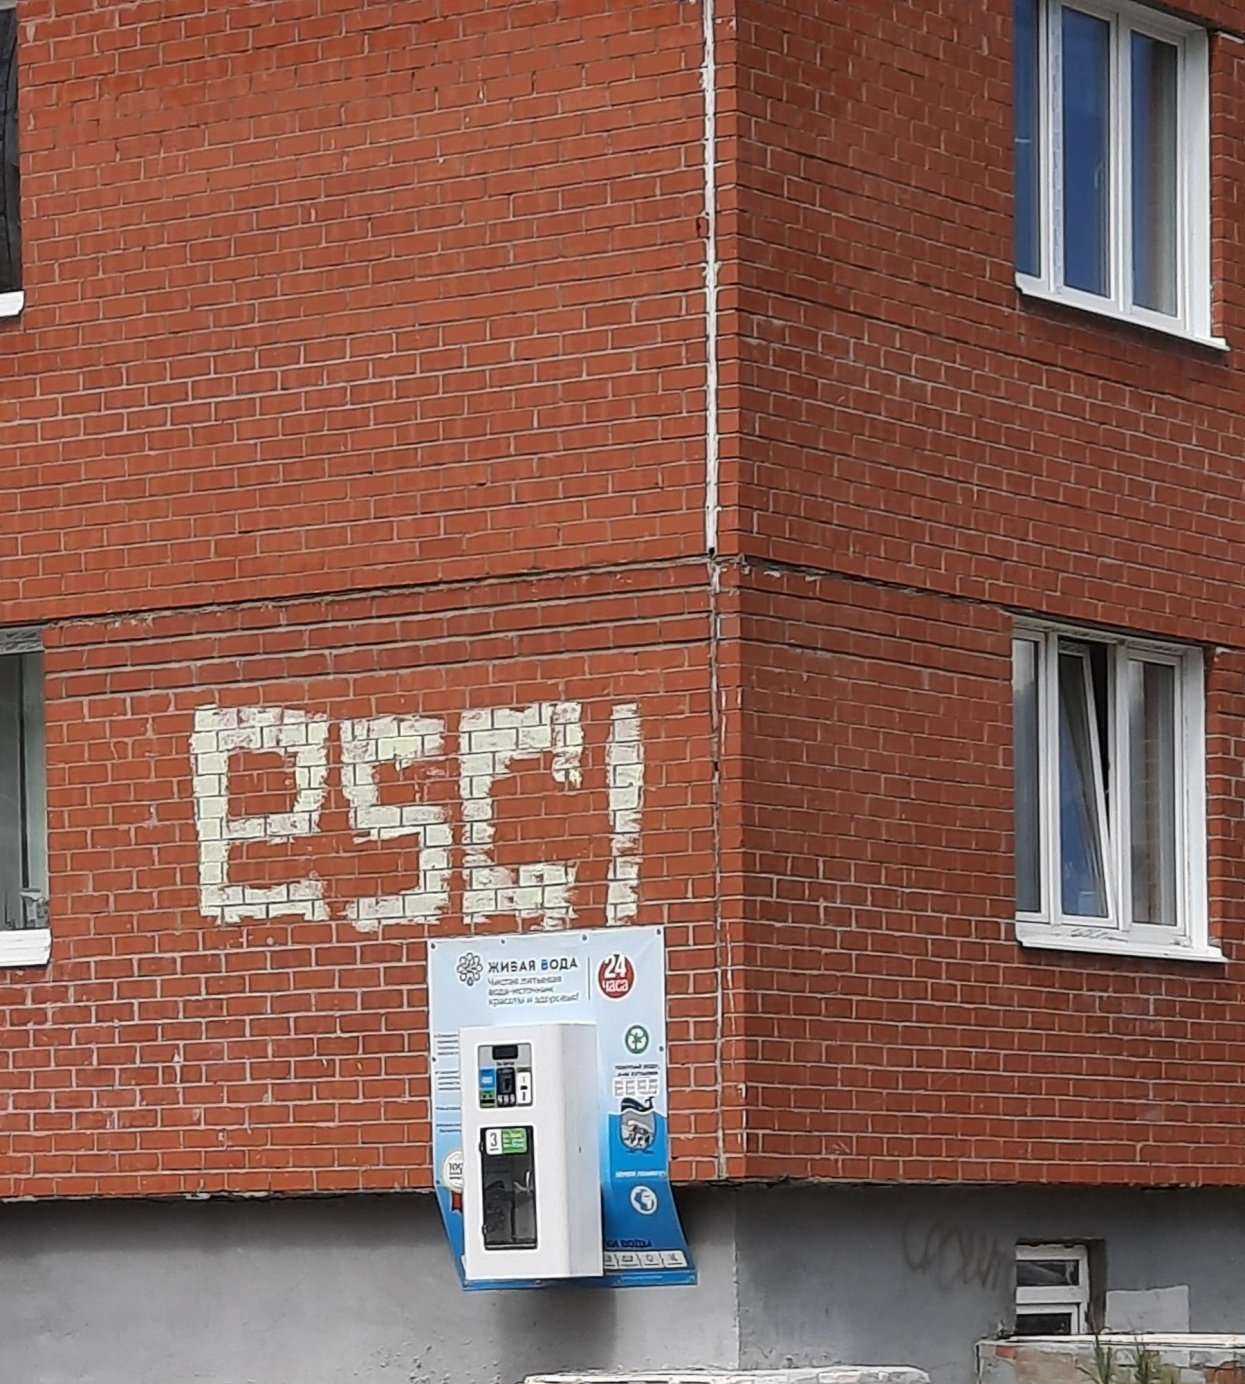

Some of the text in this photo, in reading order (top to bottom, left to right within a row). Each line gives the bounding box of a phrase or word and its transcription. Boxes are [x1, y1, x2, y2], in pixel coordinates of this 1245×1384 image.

[488, 957, 578, 974] ЖИВАЯ ВОДА
[604, 954, 627, 978] 24
[602, 979, 629, 993] часа
